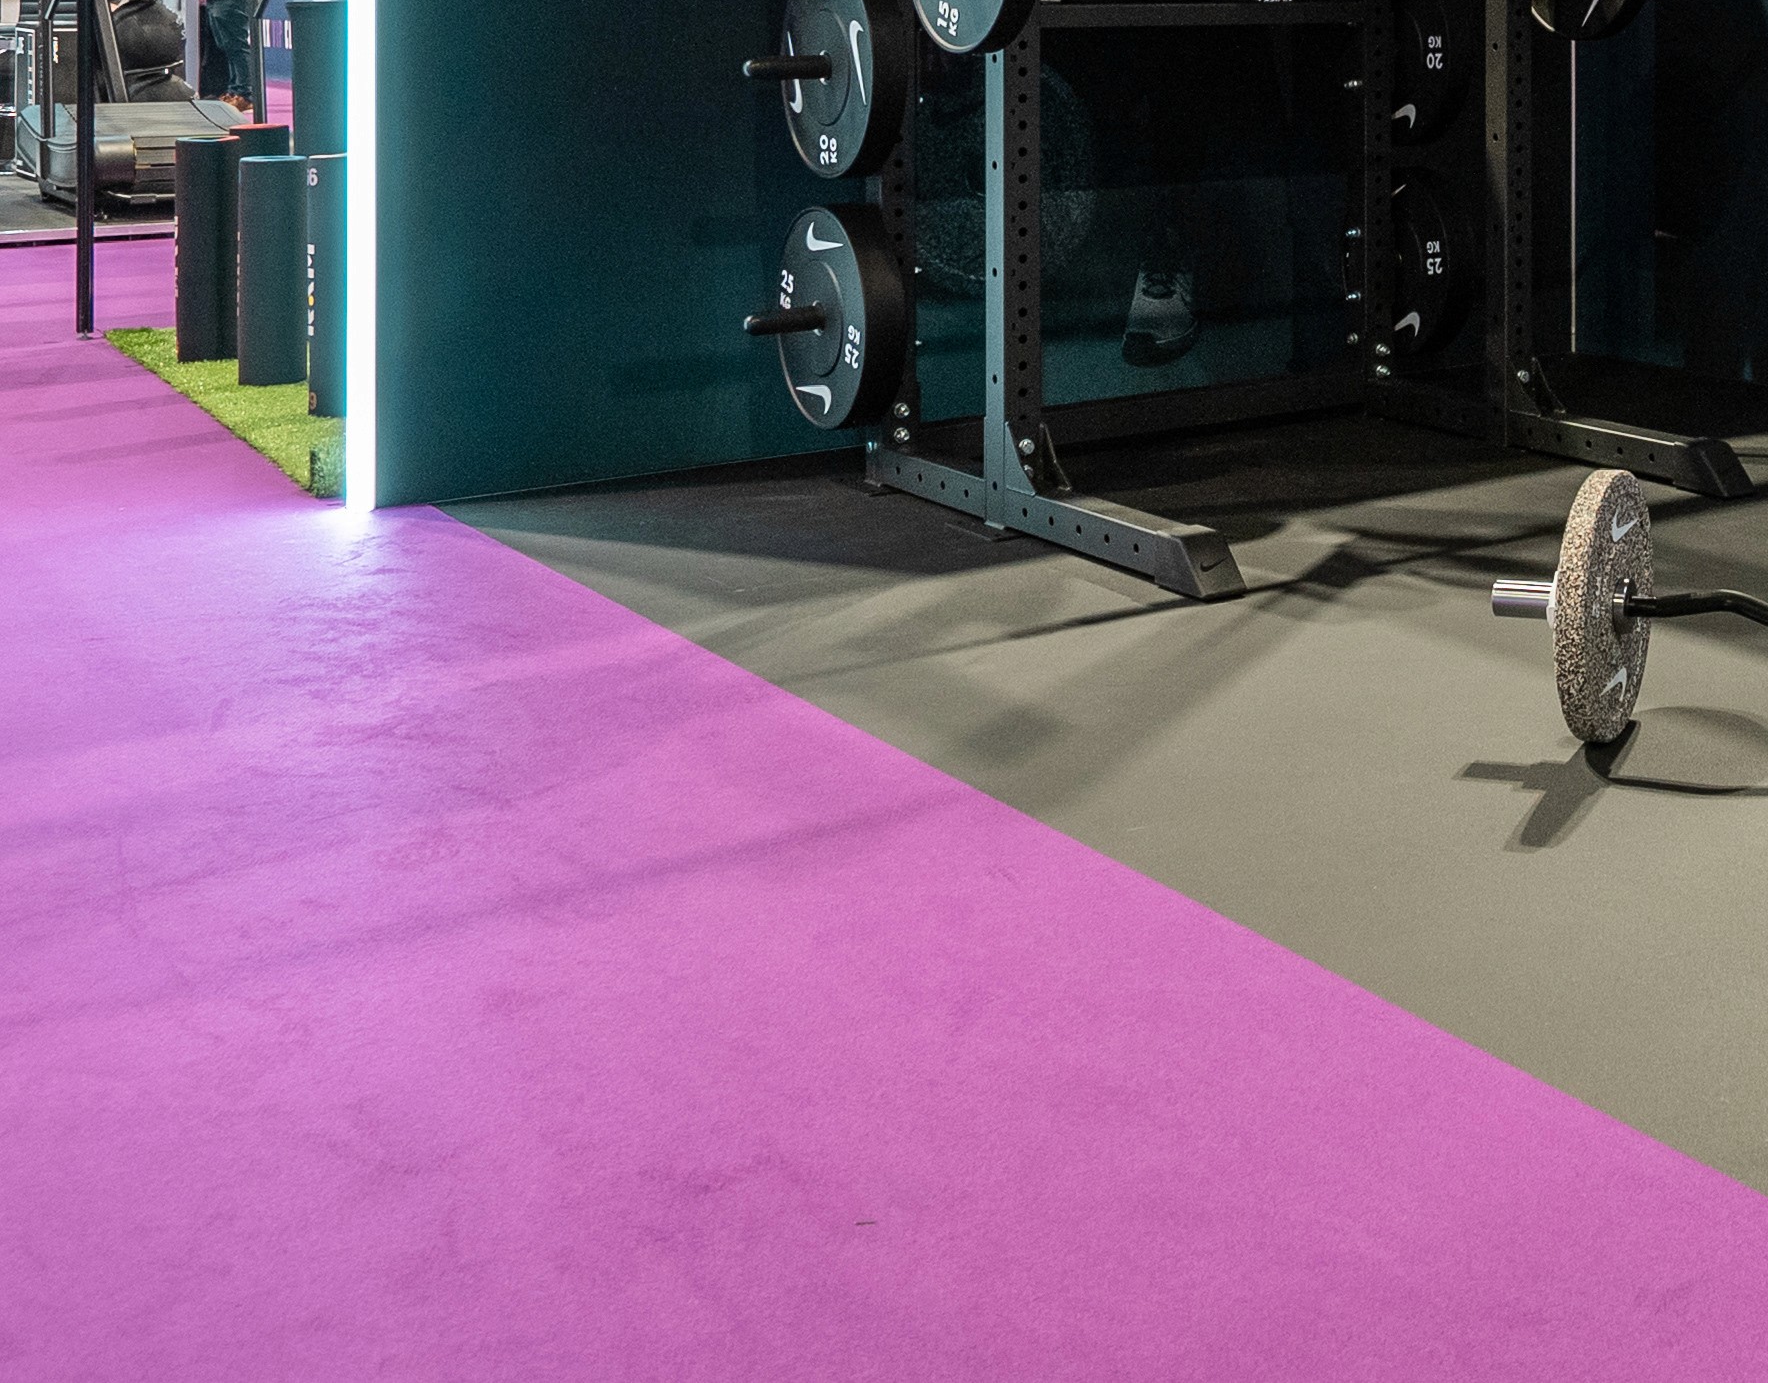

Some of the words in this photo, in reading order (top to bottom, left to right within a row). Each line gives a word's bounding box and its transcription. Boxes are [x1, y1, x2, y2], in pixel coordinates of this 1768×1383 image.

[937, 1, 949, 28] 15
[949, 8, 959, 36] KG
[1428, 36, 1442, 48] KG
[1427, 53, 1443, 69] 20
[820, 135, 829, 164] 20
[830, 138, 838, 163] KG
[1427, 241, 1440, 253] KG
[1427, 258, 1443, 275] 25
[781, 270, 794, 293] 25
[780, 293, 791, 309] KG
[848, 325, 860, 345] KG
[845, 344, 859, 368] 25
